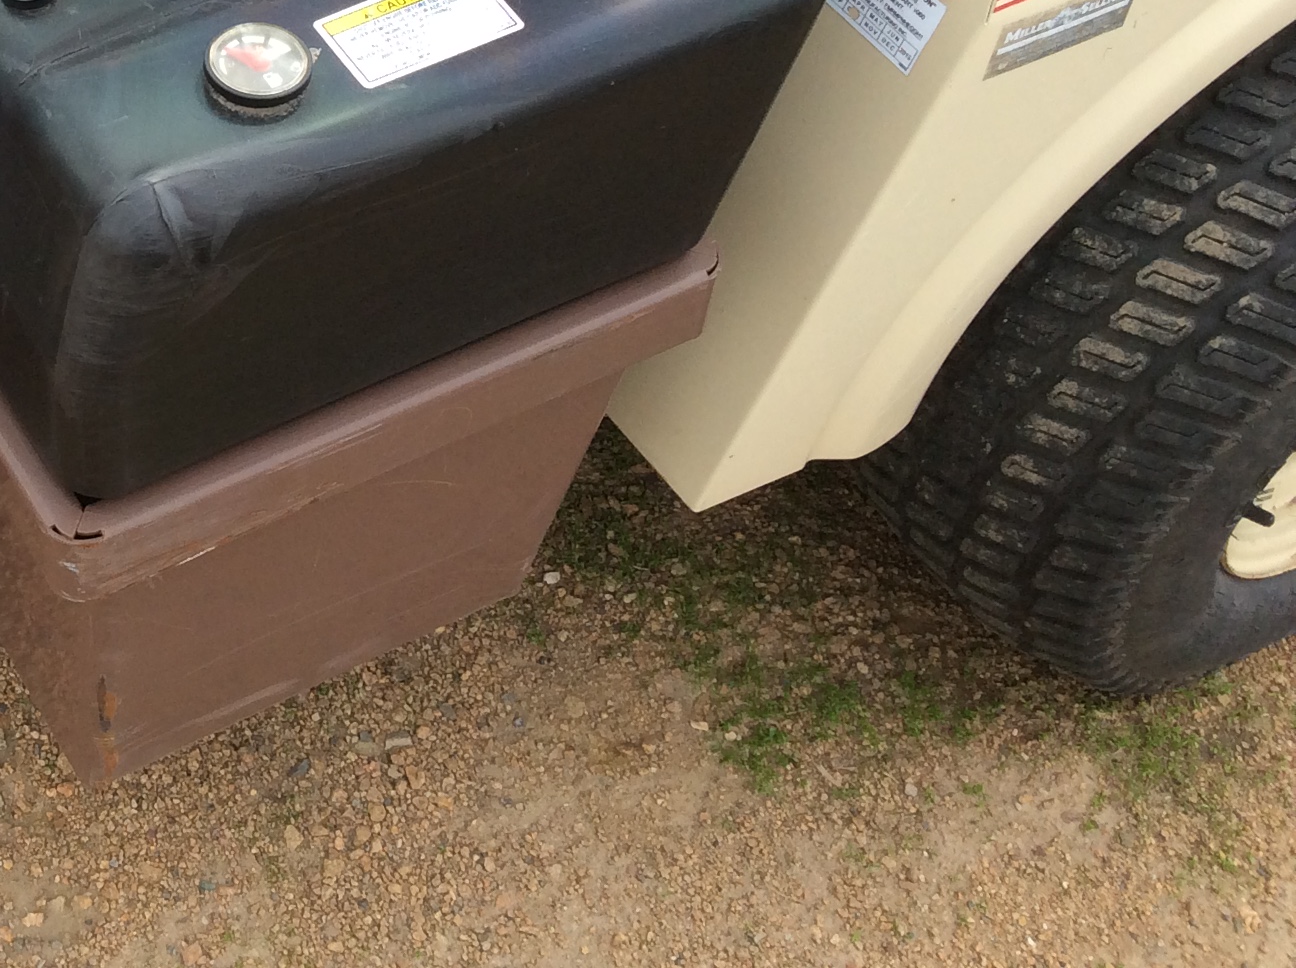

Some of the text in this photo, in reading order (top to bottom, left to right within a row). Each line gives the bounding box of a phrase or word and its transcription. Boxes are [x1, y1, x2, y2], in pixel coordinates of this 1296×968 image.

[862, 20, 878, 36] NOV
[879, 36, 895, 52] DEC
[868, 11, 884, 27] MAY
[885, 27, 900, 43] JUN
